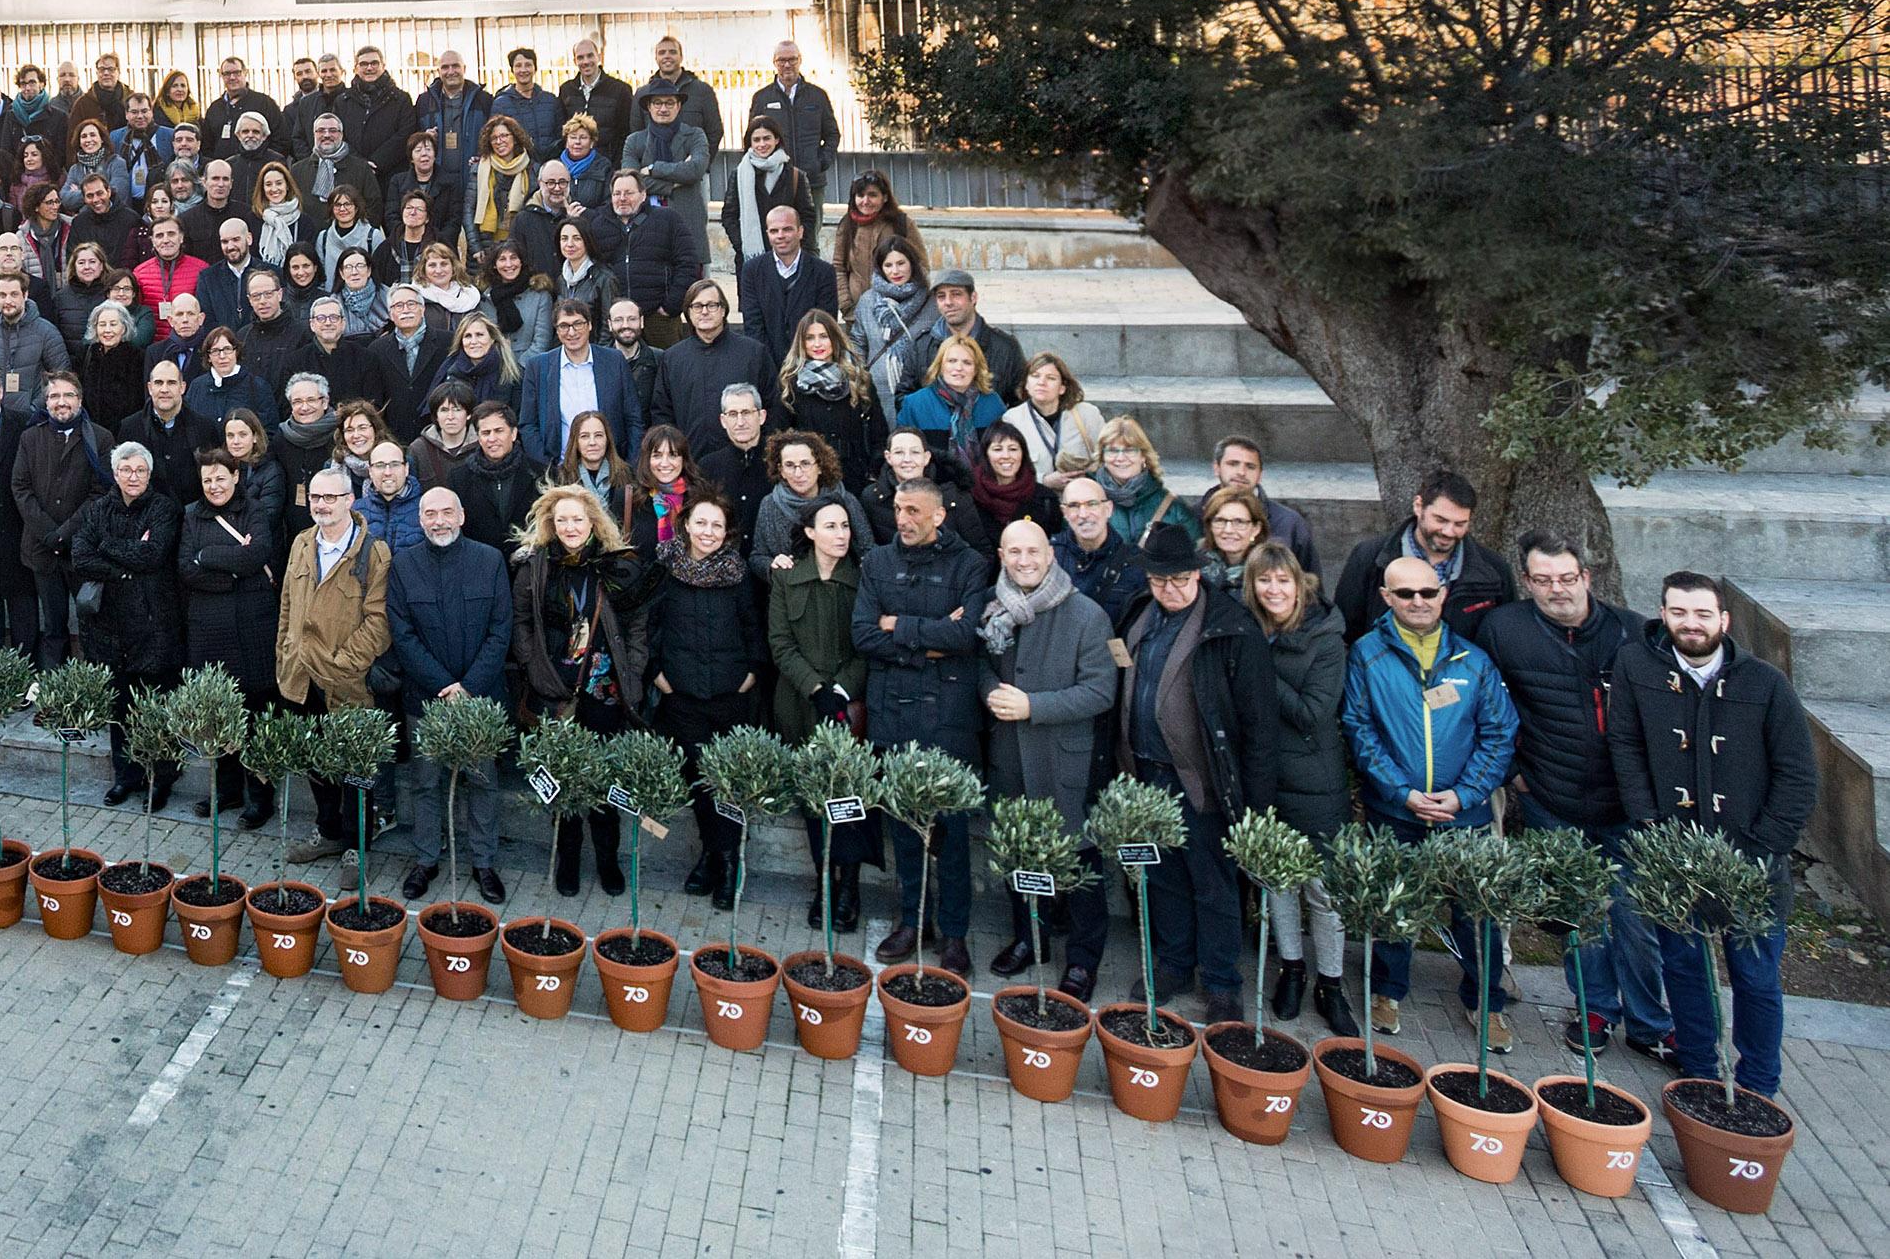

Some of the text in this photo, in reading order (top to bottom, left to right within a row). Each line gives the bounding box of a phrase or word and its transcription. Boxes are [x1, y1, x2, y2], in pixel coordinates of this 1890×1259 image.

[41, 895, 59, 911] 70
[112, 910, 132, 926] 70
[190, 924, 211, 939] 70
[273, 934, 295, 949] 70
[346, 949, 368, 965] 70
[447, 956, 470, 971] 70
[536, 976, 560, 990] 70
[624, 986, 648, 1002] 70
[717, 1001, 742, 1019] 70
[798, 1004, 822, 1024] 70
[905, 1025, 931, 1044] 70
[1022, 1048, 1051, 1068] 70
[1130, 1067, 1159, 1087] 70
[1265, 1096, 1291, 1112] 70
[1361, 1108, 1392, 1128] 70
[1470, 1133, 1503, 1154] 70
[1606, 1151, 1634, 1169] 70
[1730, 1158, 1763, 1179] 70
